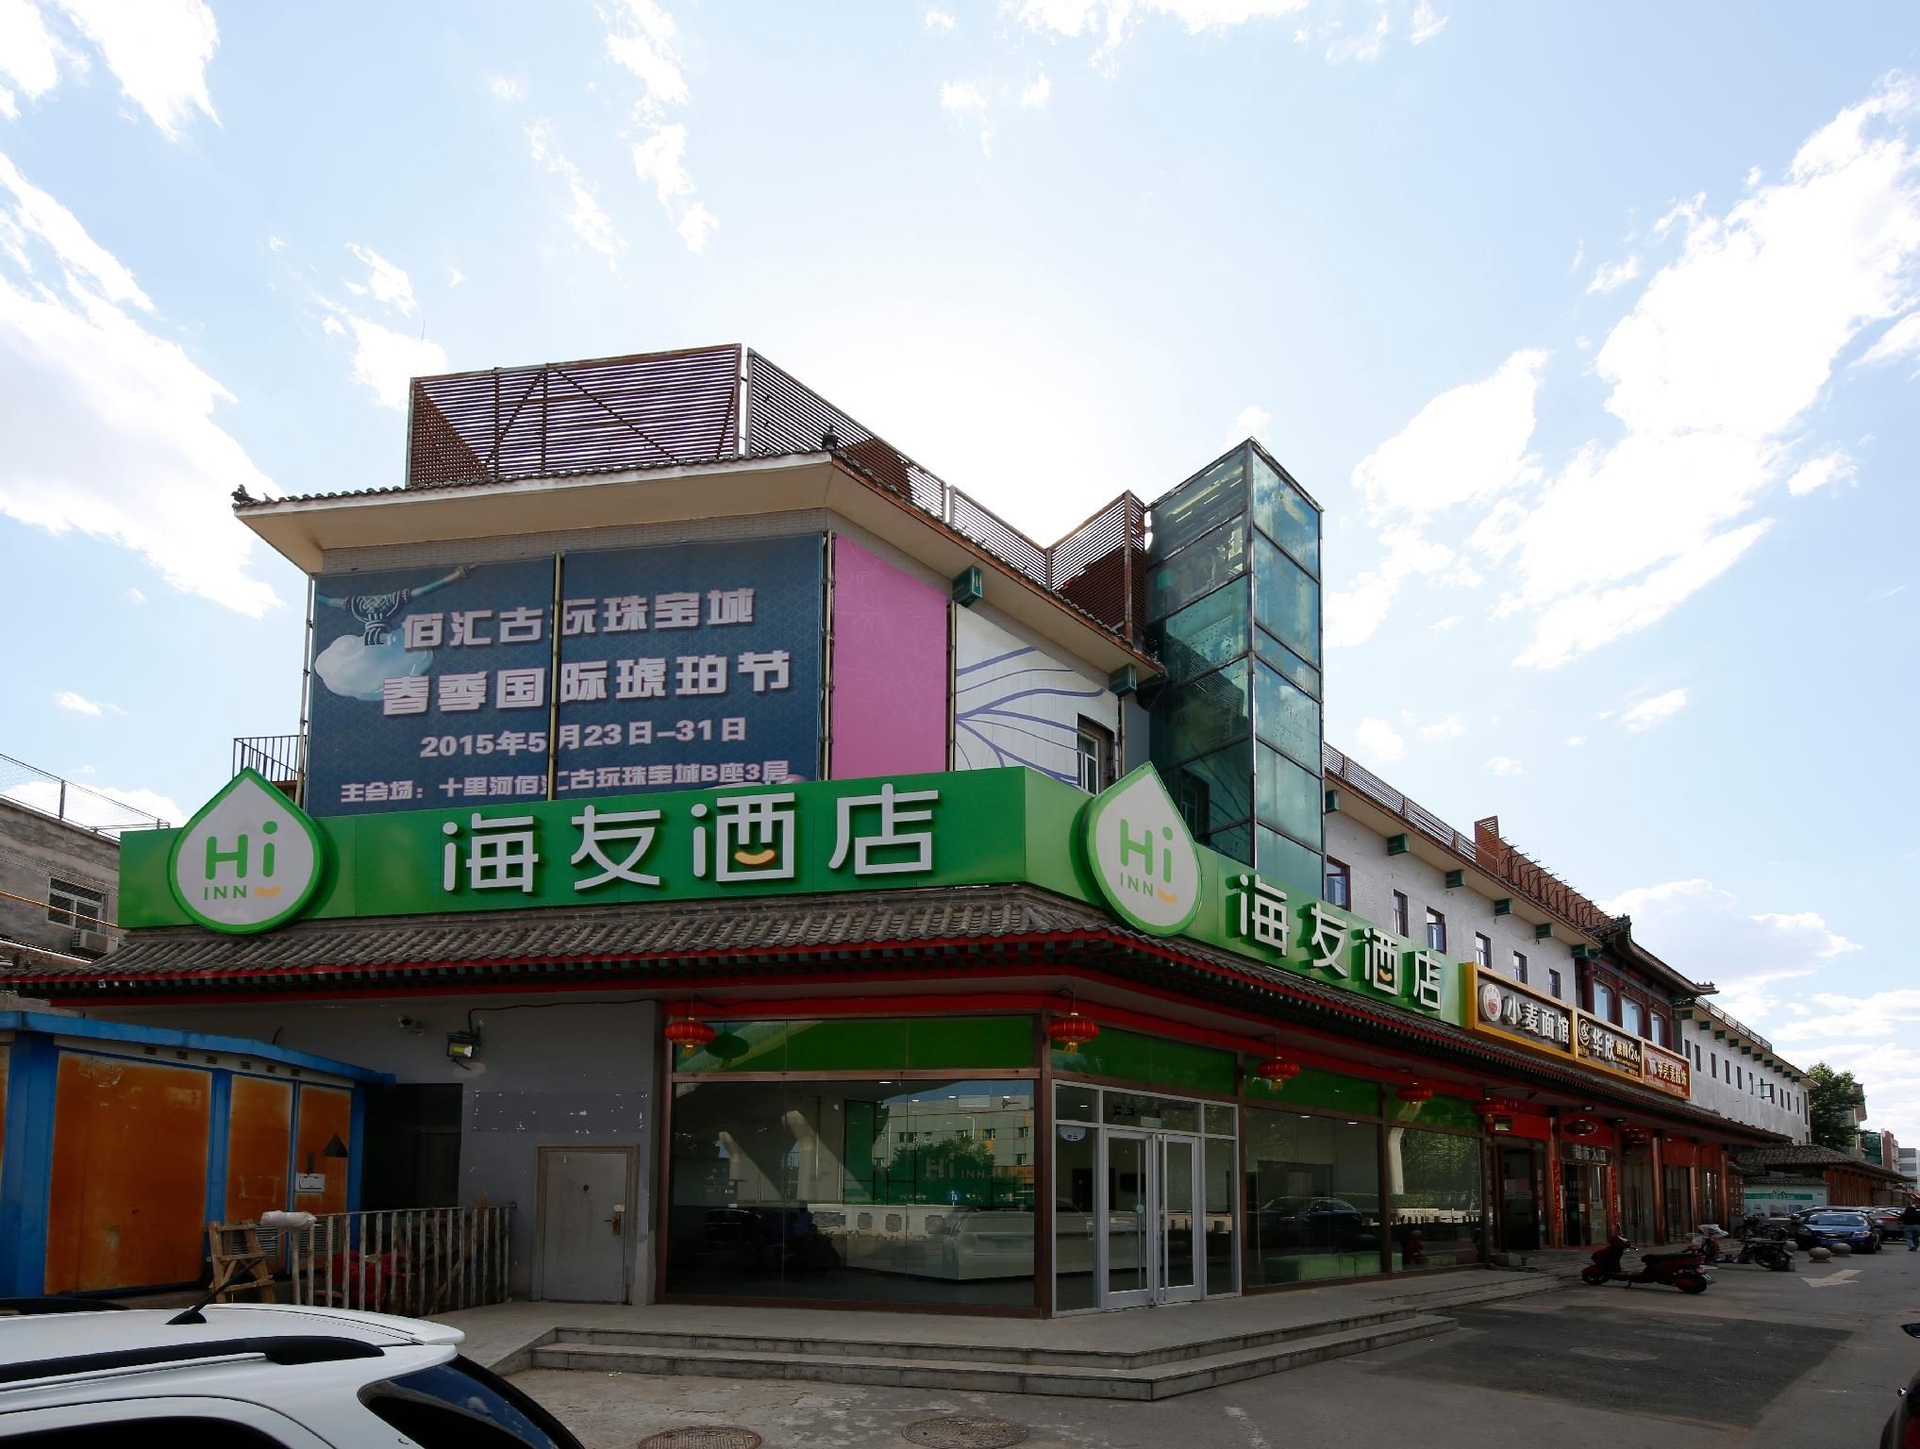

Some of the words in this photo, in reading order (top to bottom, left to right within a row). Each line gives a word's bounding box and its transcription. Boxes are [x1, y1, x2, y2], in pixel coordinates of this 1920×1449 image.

[402, 588, 755, 649] 佰汇古玩珠宝城
[384, 651, 790, 715] 春季国际琥珀节
[205, 821, 278, 880] Hi
[442, 783, 939, 893] 海友酒店
[1120, 819, 1173, 883] Hi
[204, 885, 247, 900] INN
[1120, 872, 1154, 897] INN
[1238, 873, 1442, 1009] 海友酒店
[1505, 995, 1569, 1044] 小麦面馆
